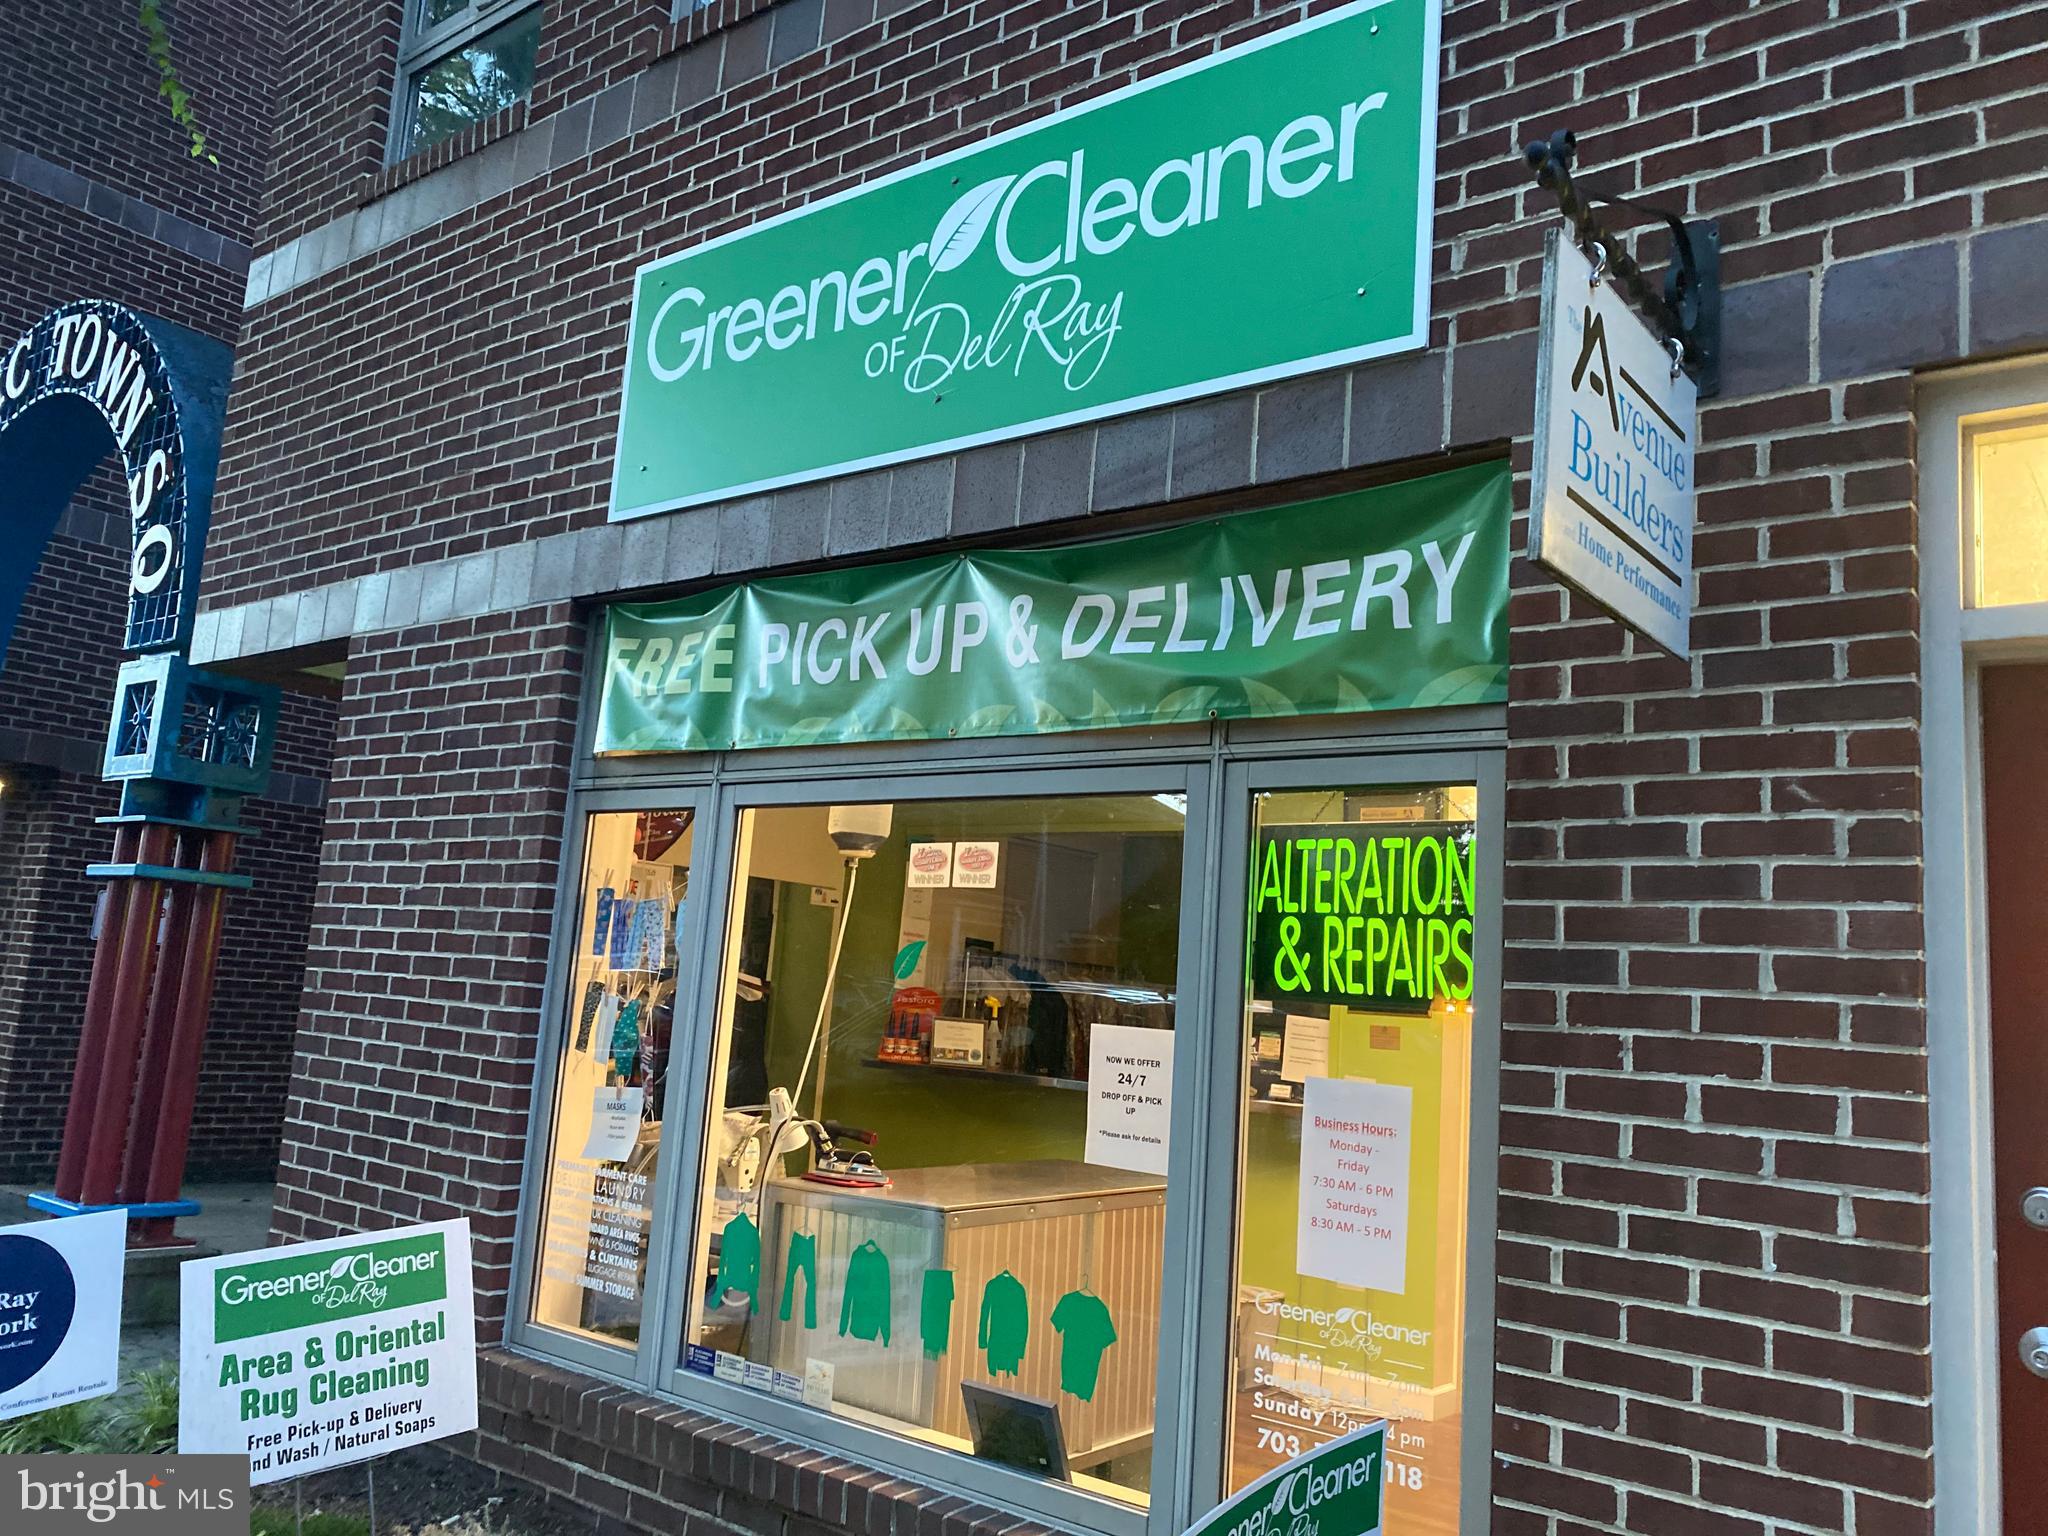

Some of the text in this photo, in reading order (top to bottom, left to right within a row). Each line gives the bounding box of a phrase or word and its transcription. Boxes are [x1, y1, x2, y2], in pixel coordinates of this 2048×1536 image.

[646, 91, 1388, 384] Greener Cleaner
[864, 273, 1125, 393] OF Del Ray
[51, 313, 155, 450] TOWN
[1572, 304, 1686, 492] Avenue
[1568, 409, 1684, 562] Builders
[1577, 521, 1681, 620] Home Performance
[608, 531, 1476, 698] FREE PICK UP & DELIVERY
[1258, 836, 1476, 916] ALTERATION
[1274, 916, 1474, 1000] & REPAIRS
[1106, 1055, 1161, 1068] NOW WE OFFER
[1117, 1072, 1147, 1088] 24/7
[606, 1102, 627, 1111] MASKS
[1101, 1091, 1163, 1106] DROP OFF & PICK
[1125, 1107, 1136, 1115] UP
[1314, 1116, 1360, 1134] Business
[1141, 1135, 1161, 1144] details
[1329, 1138, 1373, 1156] Monday
[628, 1173, 647, 1185] CARE
[1337, 1159, 1370, 1175] Friday
[595, 1178, 646, 1201] LAUNDRY
[1313, 1176, 1336, 1189] 7:30
[1338, 1180, 1356, 1192] AM
[1366, 1184, 1373, 1195] 6
[1375, 1186, 1394, 1198] PM
[1326, 1198, 1377, 1218] Saturdays
[625, 1230, 641, 1243] RUGS
[1311, 1217, 1334, 1230] 8:30
[1336, 1221, 1354, 1233] AM
[1364, 1226, 1371, 1237] 5
[1374, 1228, 1392, 1240] PM
[589, 1250, 596, 1261] &
[598, 1252, 638, 1271] CURTAINS
[611, 1240, 639, 1256] FORMALS
[221, 1250, 440, 1305] Greener Cleaner
[312, 1281, 388, 1309] OF Del Ray
[605, 1281, 635, 1300] STORAGE
[1255, 1292, 1432, 1346] Greener Cleaner
[218, 1311, 446, 1388] Area & Oriental
[52, 1388, 75, 1399] Room
[240, 1357, 430, 1422] Rug Cleaning
[1254, 1391, 1325, 1427] Sunday
[247, 1399, 423, 1451] Free Pick-up & Delivery
[250, 1416, 436, 1473] nd Wash / Natural Soaps
[1257, 1428, 1300, 1458] 703
[1288, 1452, 1376, 1515] Cleaner
